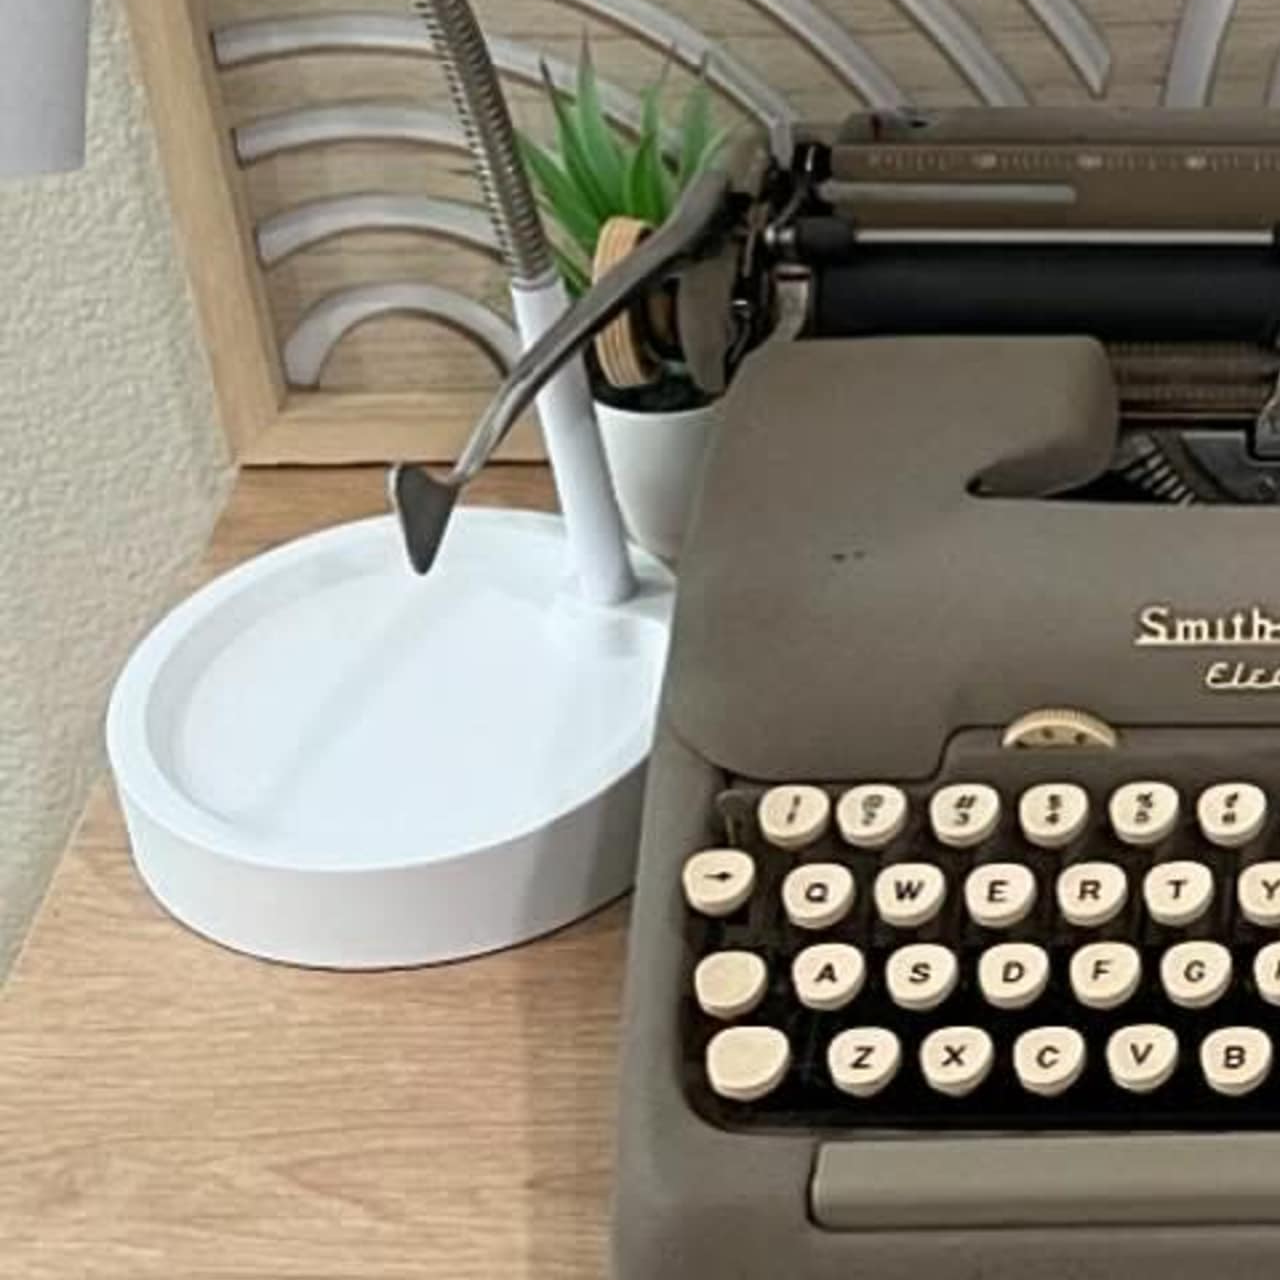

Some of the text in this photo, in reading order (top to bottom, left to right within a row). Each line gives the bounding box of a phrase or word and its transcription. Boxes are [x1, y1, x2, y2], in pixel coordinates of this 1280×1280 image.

[803, 881, 830, 905] Q
[893, 879, 926, 903] W
[985, 879, 1010, 905] E
[1076, 878, 1103, 902] R
[1165, 878, 1189, 901] T
[812, 961, 839, 985] A
[907, 961, 932, 986] S
[1001, 959, 1027, 985] D
[1090, 959, 1113, 982] F
[1182, 959, 1207, 984] G
[848, 1044, 876, 1071] Z
[940, 1044, 968, 1068] X
[1034, 1044, 1061, 1070] C
[1129, 1042, 1155, 1067] V
[1221, 1044, 1247, 1071] B
